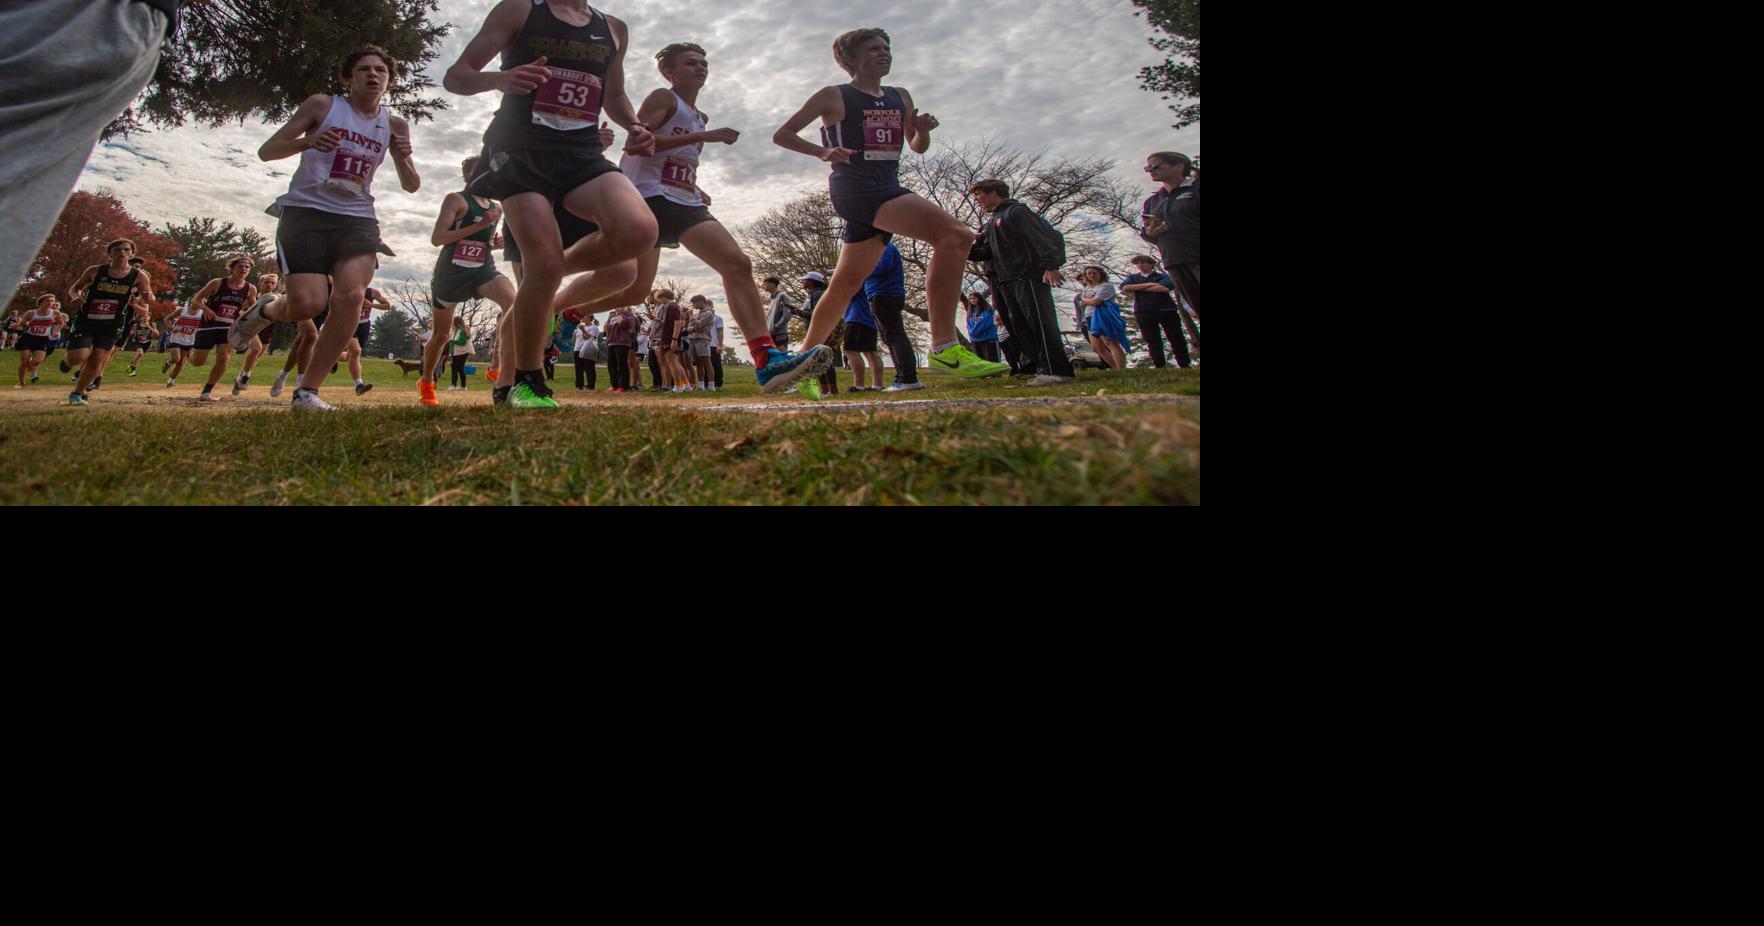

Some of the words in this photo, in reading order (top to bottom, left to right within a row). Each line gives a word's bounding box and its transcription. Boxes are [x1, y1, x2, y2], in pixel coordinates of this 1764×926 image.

[558, 82, 588, 107] 53
[331, 127, 382, 153] AINTS
[876, 128, 892, 143] 91
[343, 157, 373, 178] 113
[671, 165, 693, 184] 114
[462, 245, 482, 257] 127
[97, 304, 111, 312] 42
